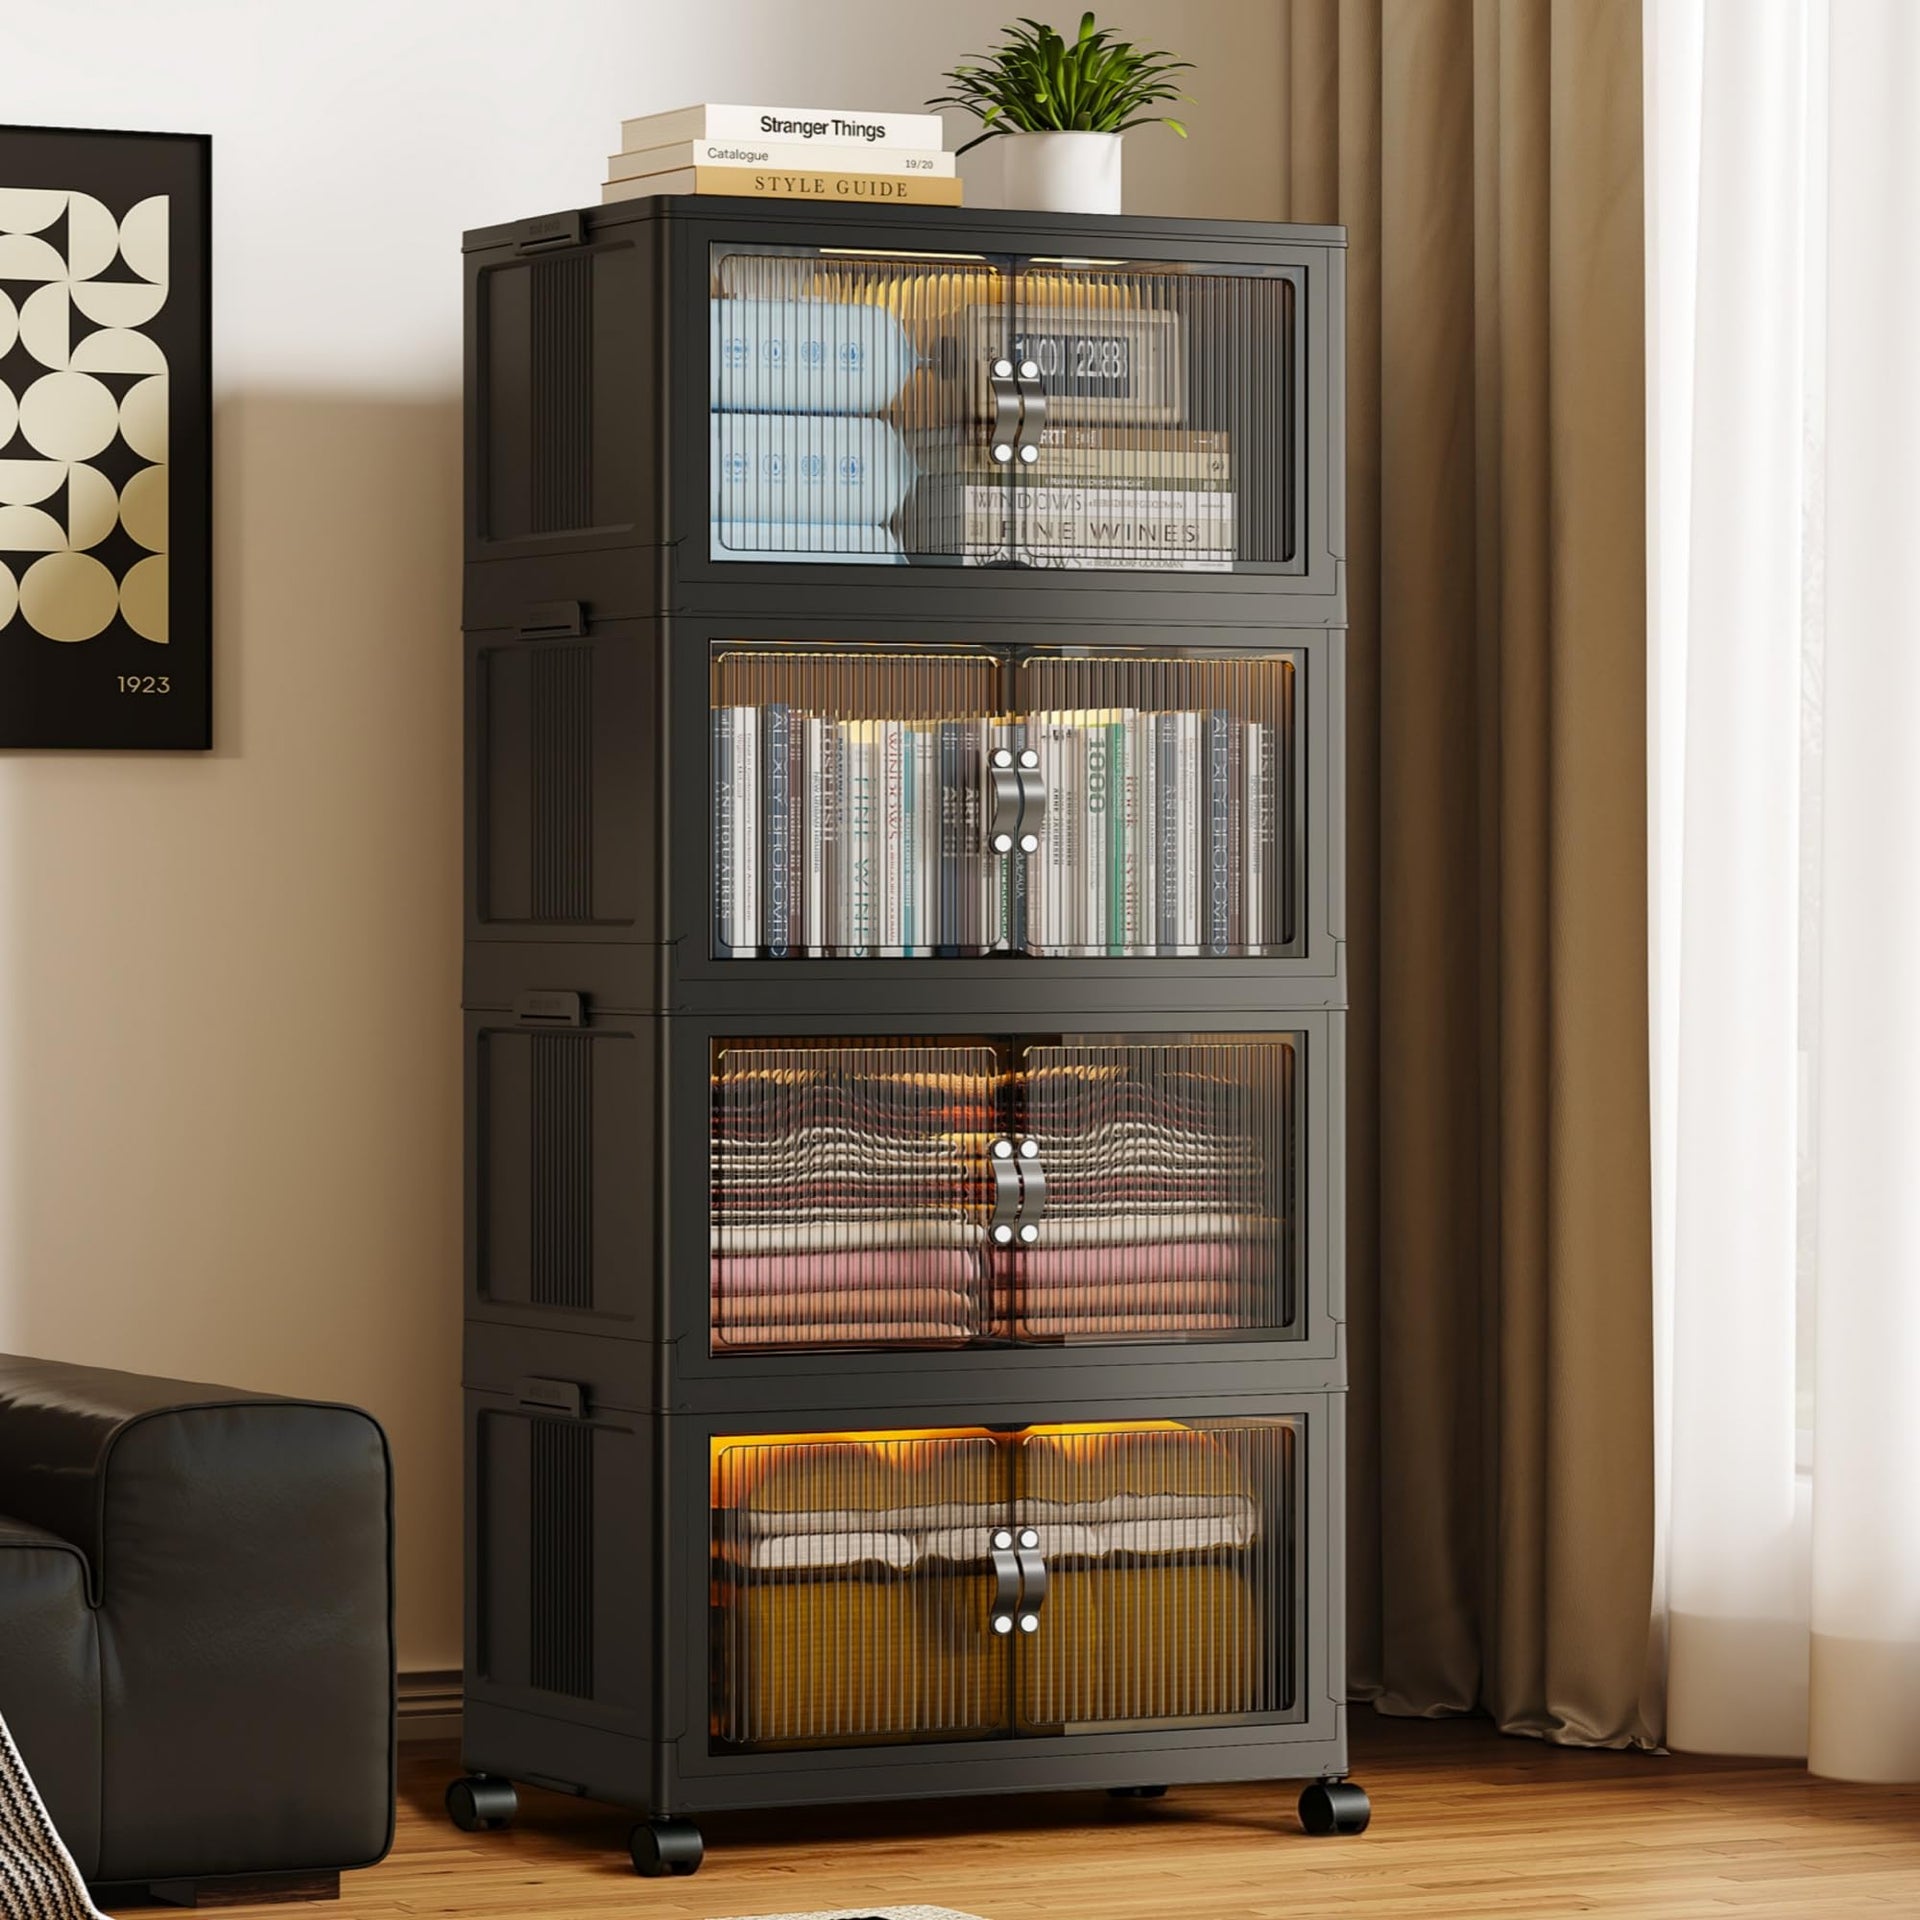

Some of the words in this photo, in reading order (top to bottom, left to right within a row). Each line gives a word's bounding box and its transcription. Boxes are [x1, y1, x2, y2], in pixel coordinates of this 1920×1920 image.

[760, 115, 829, 139] Stranger
[831, 119, 886, 142] Things
[707, 147, 769, 163] Catalogue
[905, 159, 934, 170] 19/20
[754, 176, 825, 194] STYLE
[836, 180, 908, 198] GUIDE
[1089, 522, 1199, 543] WINES
[116, 675, 171, 694] 1923
